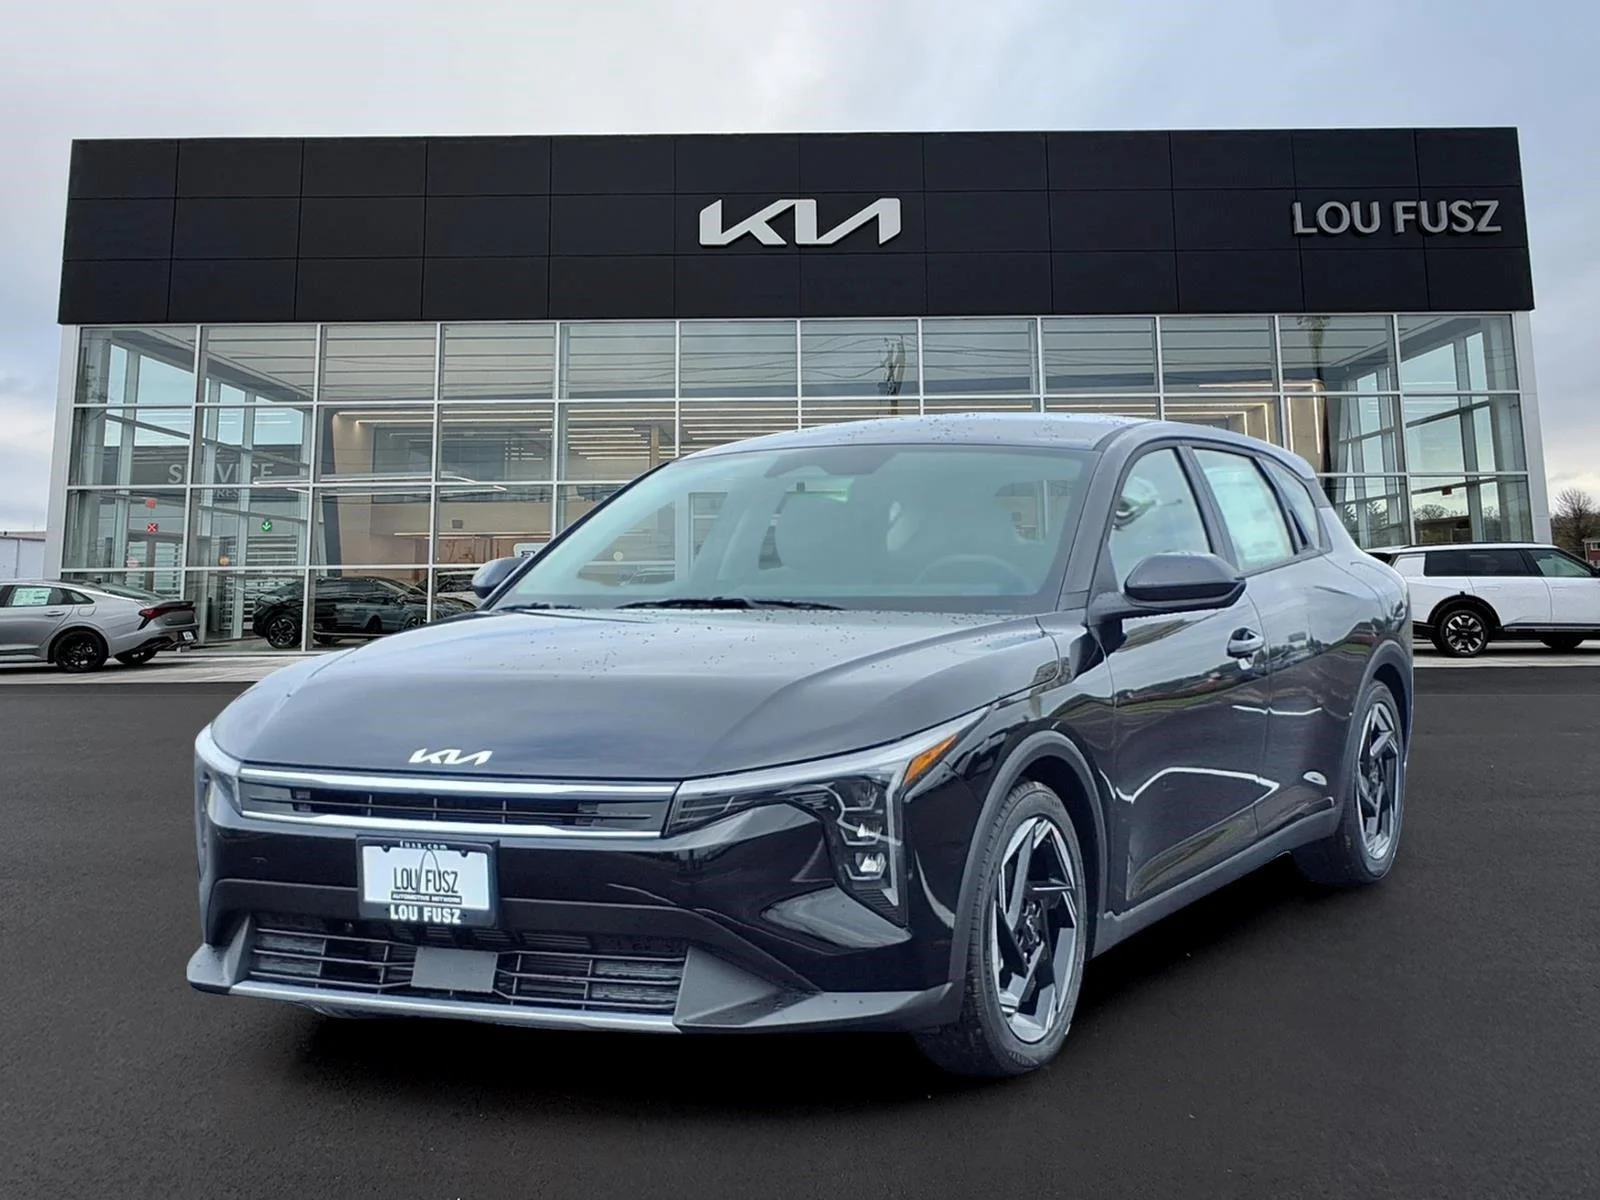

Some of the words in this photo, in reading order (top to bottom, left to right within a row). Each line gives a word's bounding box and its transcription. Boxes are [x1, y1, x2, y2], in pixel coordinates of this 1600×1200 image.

[699, 197, 902, 246] KIA
[1292, 200, 1381, 235] LOU
[1393, 199, 1503, 234] FUSZ
[408, 747, 493, 766] KIA
[394, 867, 418, 891] LOU
[425, 869, 459, 894] FUSZ
[390, 904, 418, 921] LOU
[423, 907, 462, 924] FUSZ
